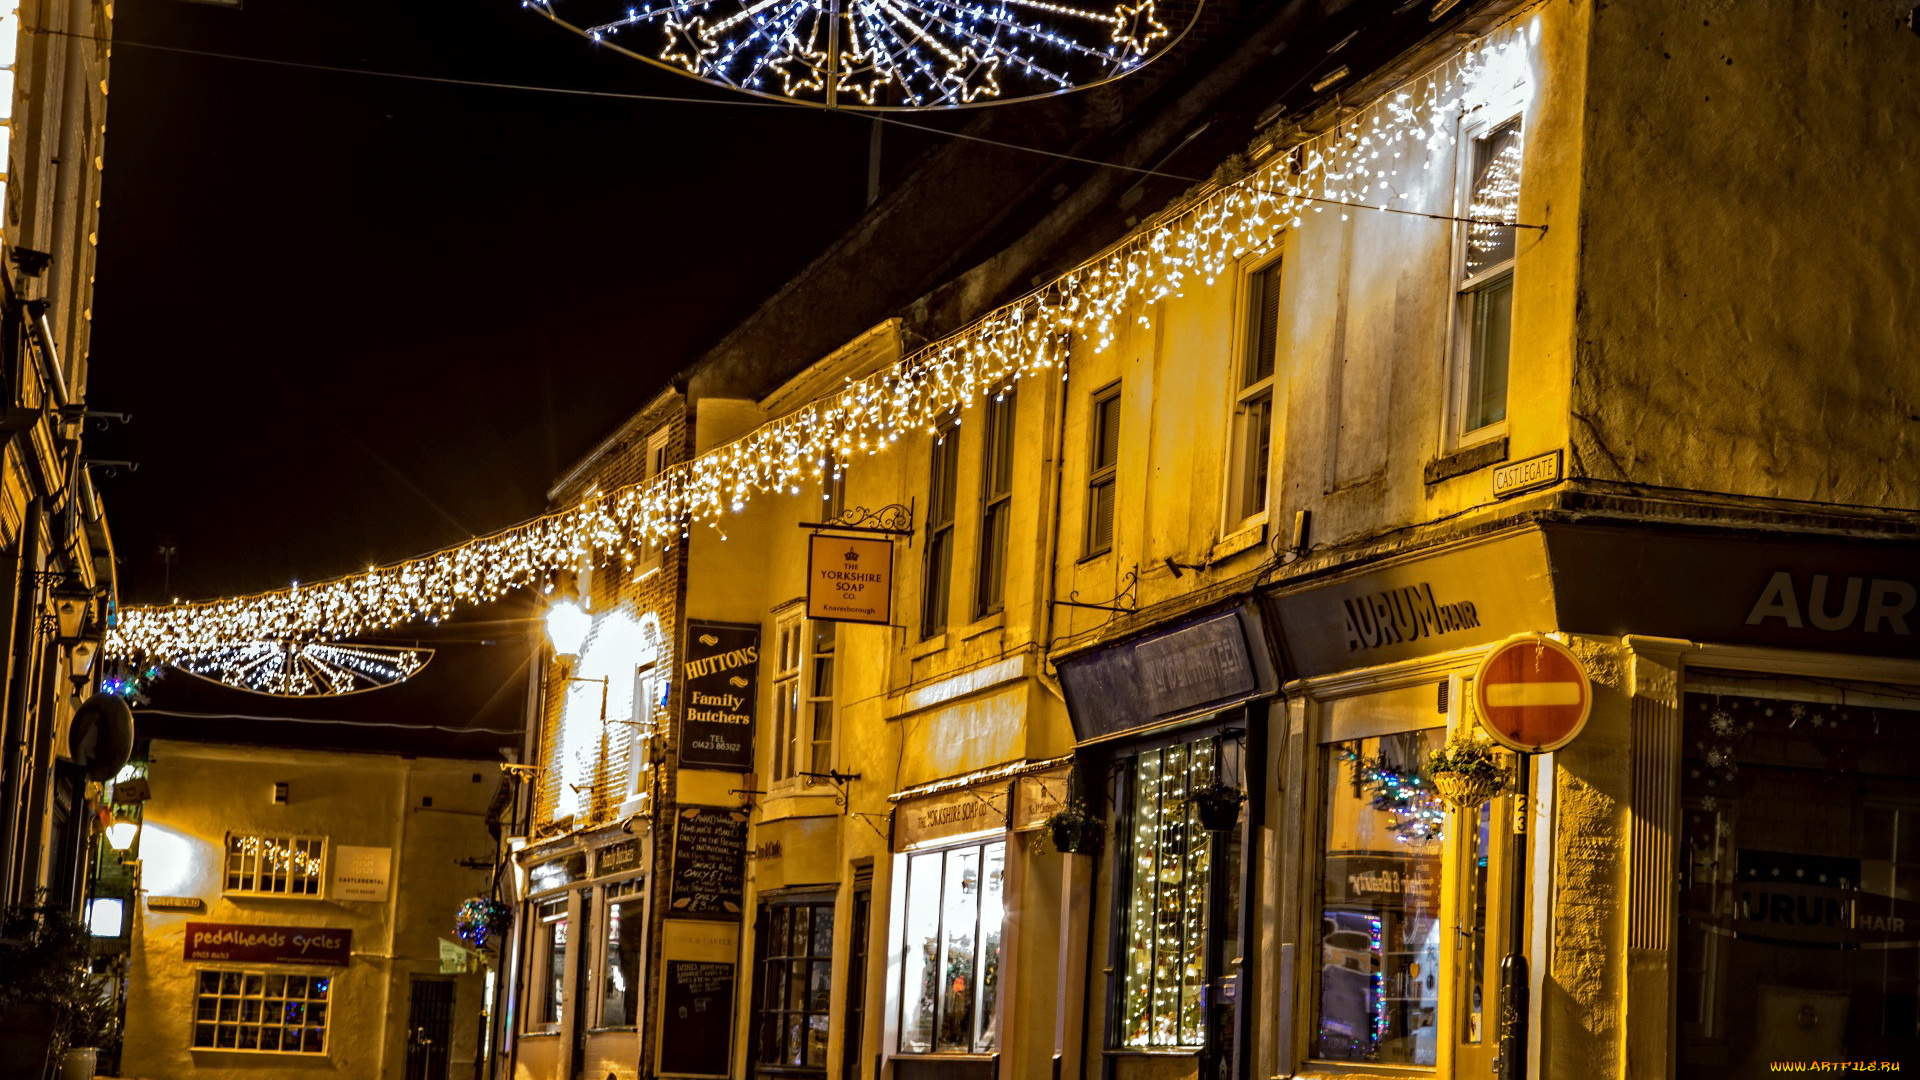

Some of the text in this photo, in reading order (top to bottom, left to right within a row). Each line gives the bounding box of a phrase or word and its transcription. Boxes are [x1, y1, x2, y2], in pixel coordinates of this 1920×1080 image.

[1497, 457, 1553, 490] CASTLEGATE
[821, 570, 882, 583] YORKSHIRE
[844, 563, 859, 571] THE
[836, 582, 865, 592] SOAP
[823, 604, 877, 615] Knaresborough
[1744, 571, 1918, 636] AUR
[1344, 581, 1481, 651] AURUM HAIR
[685, 645, 759, 681] HUTTONS
[691, 691, 746, 712] Family
[687, 707, 750, 725] Butchers
[692, 741, 714, 750] 01423
[917, 815, 927, 830] THE
[927, 804, 961, 828] YORKSHIRE
[962, 801, 979, 822] SOAP
[338, 877, 384, 885] CASTLEDENTAL
[1713, 889, 1905, 933] AURUM HAIR
[194, 929, 342, 955] pedalheads cycles
